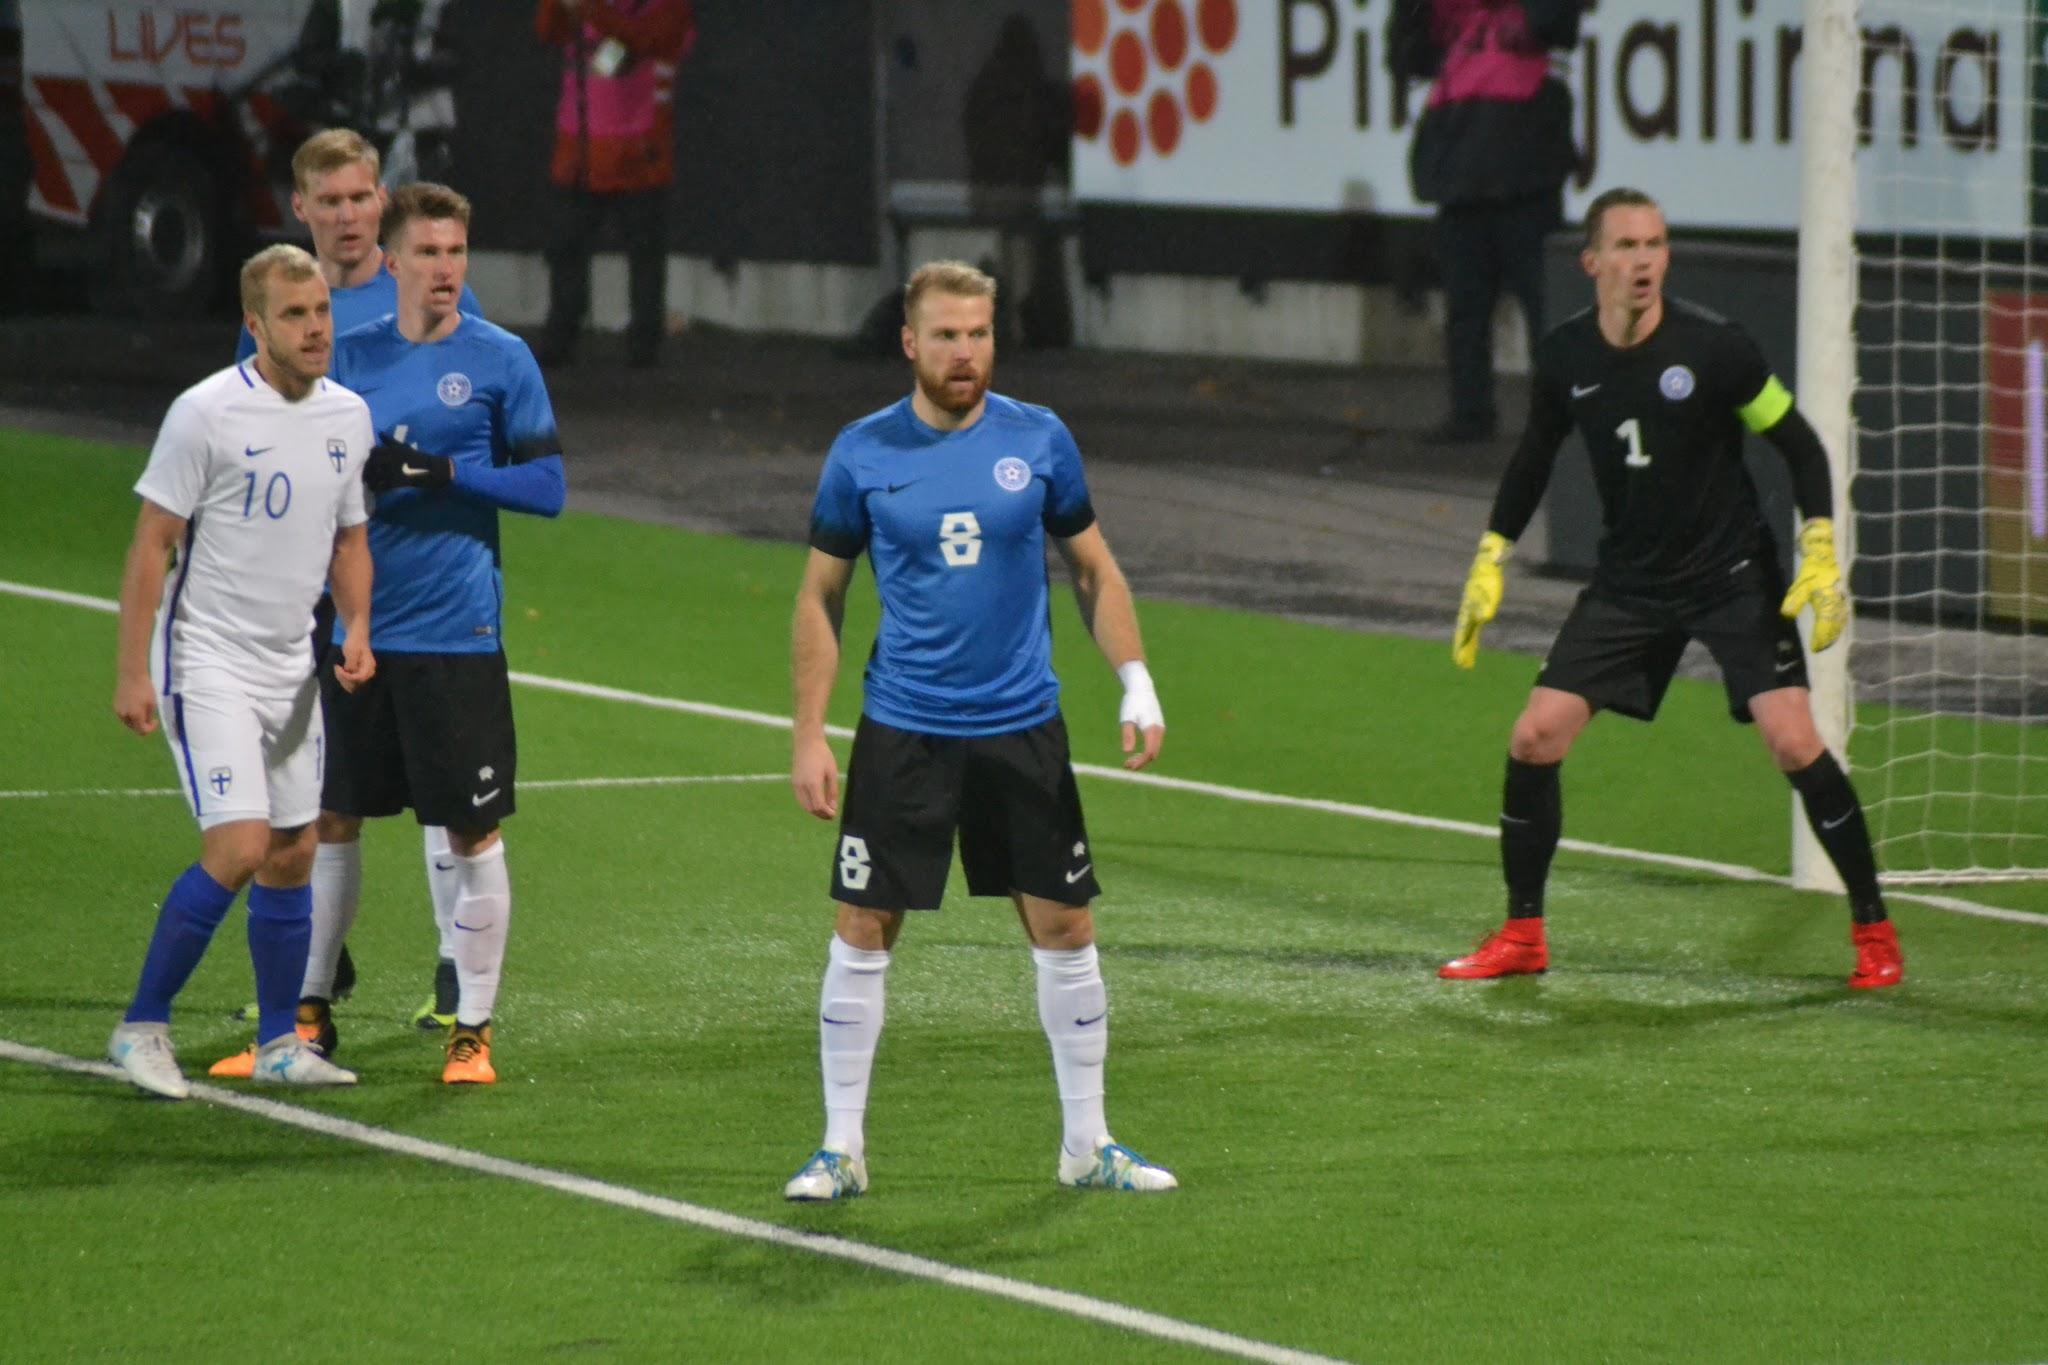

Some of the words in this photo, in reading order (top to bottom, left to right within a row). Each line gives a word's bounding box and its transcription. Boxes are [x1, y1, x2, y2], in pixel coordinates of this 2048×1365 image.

[1279, 0, 1999, 191] Pijalina
[1615, 417, 1653, 468] 1
[242, 470, 292, 520] 10
[938, 511, 984, 567] 8
[838, 835, 873, 891] 8
